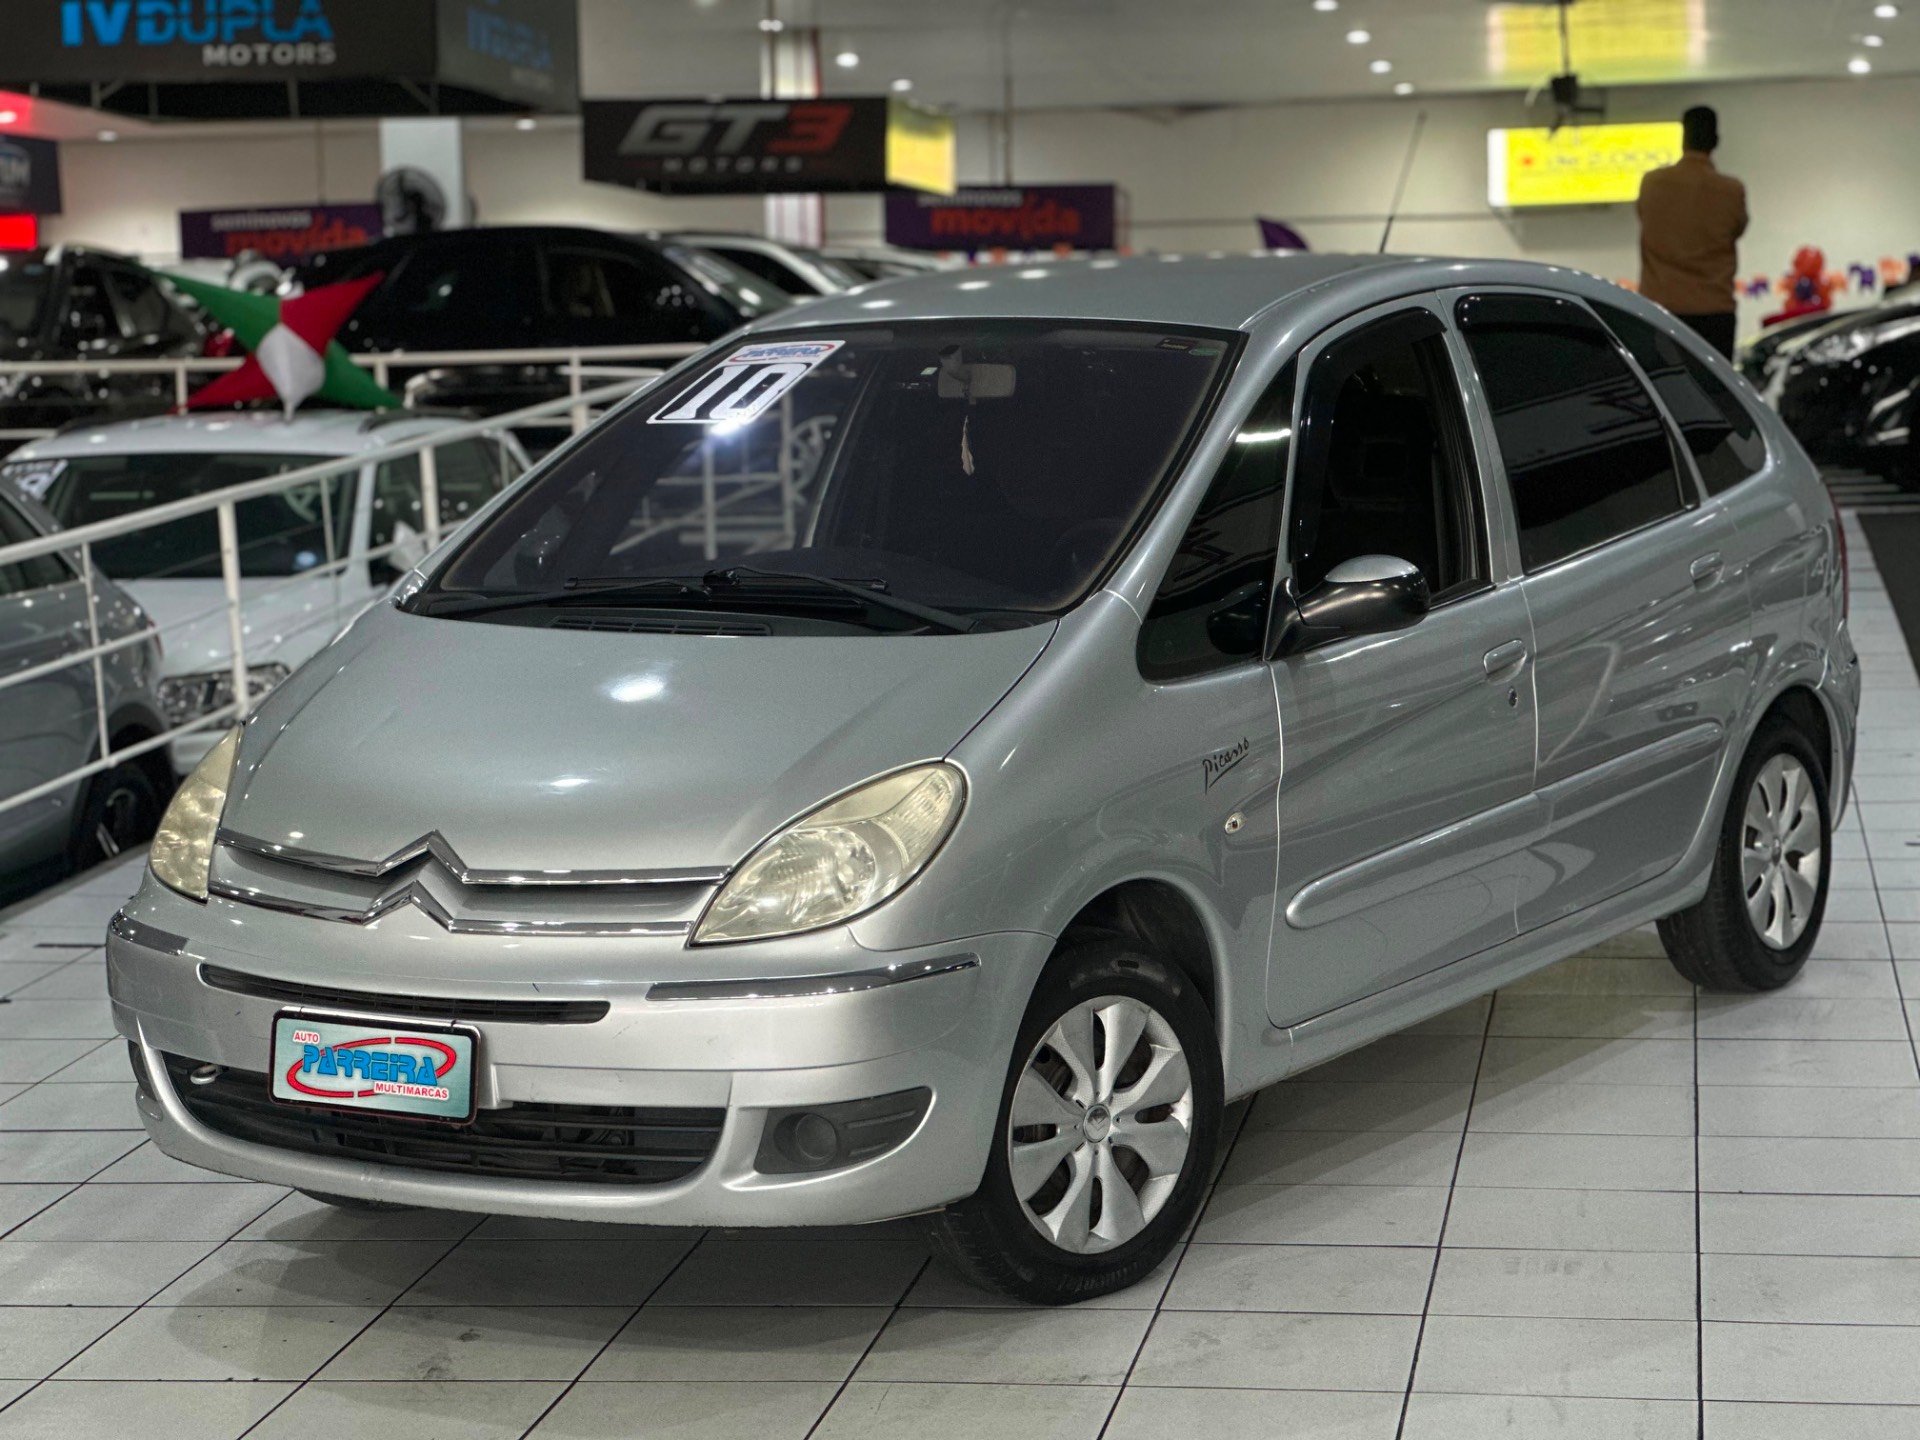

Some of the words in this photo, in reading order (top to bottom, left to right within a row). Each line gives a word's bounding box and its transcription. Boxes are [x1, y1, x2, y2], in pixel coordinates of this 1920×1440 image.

[202, 42, 336, 66] MOTORS
[618, 103, 852, 155] GT3
[662, 154, 803, 174] MOTORS
[293, 1031, 319, 1043] AUTO
[374, 1083, 448, 1099] MULTIMARCAS
